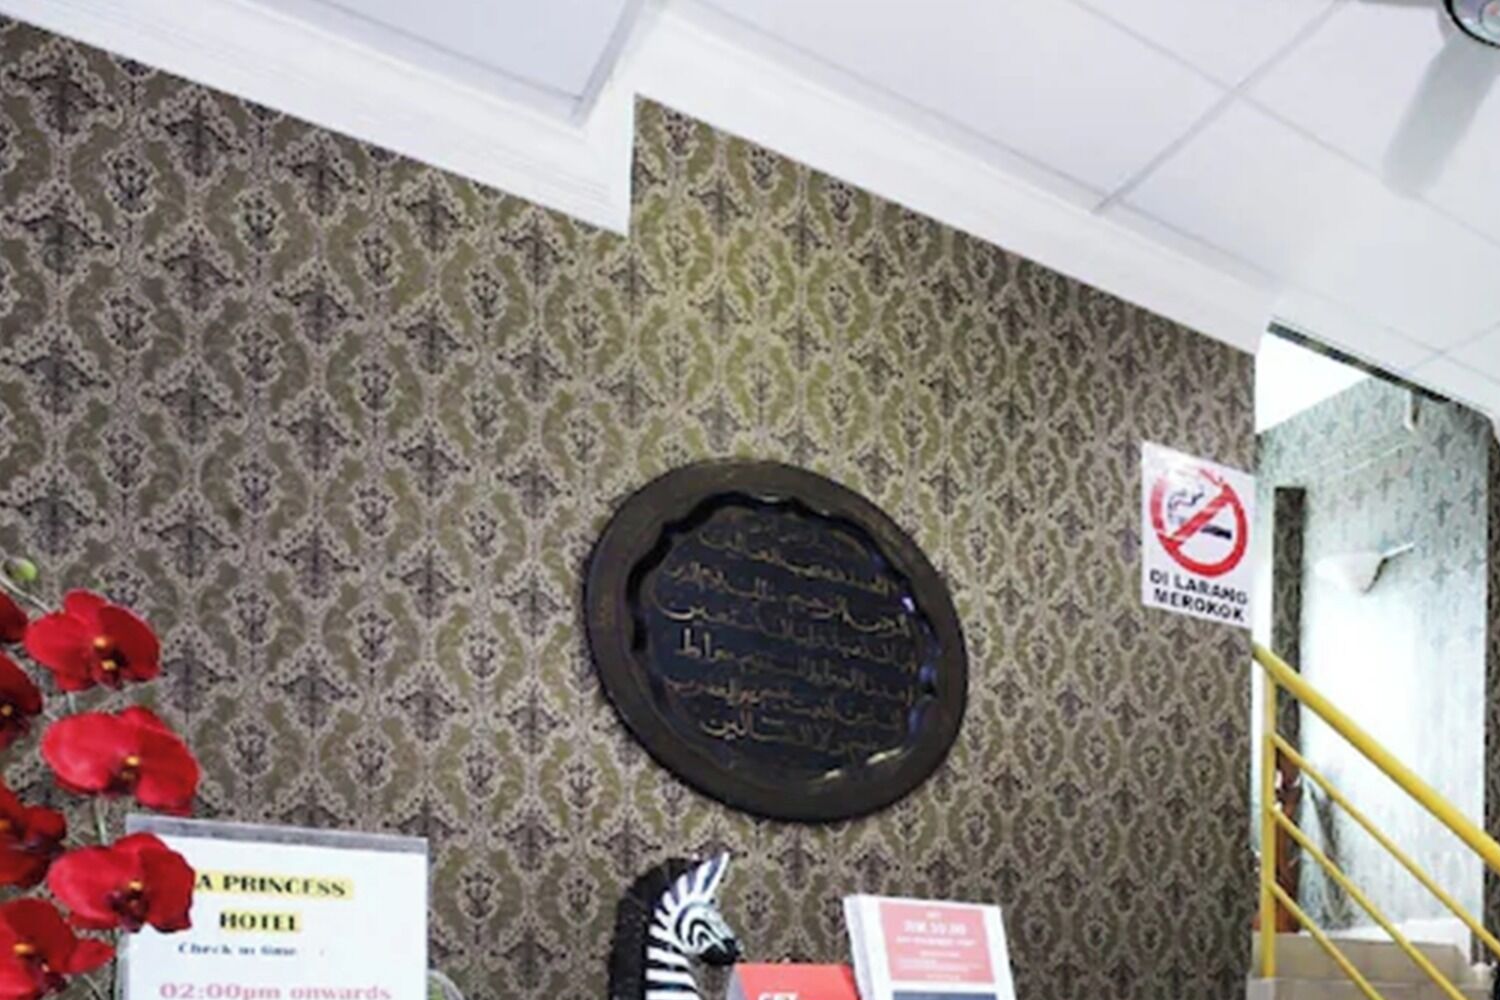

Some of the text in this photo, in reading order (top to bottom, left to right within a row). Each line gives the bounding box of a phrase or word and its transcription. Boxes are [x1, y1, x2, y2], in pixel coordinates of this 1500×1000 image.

[1149, 569, 1248, 605] DI LARANG
[1154, 588, 1245, 622] MEROKOK
[223, 874, 346, 897] PRINCESS
[219, 911, 299, 932] HOTEL
[178, 941, 232, 956] Check
[289, 984, 393, 1000] onwards
